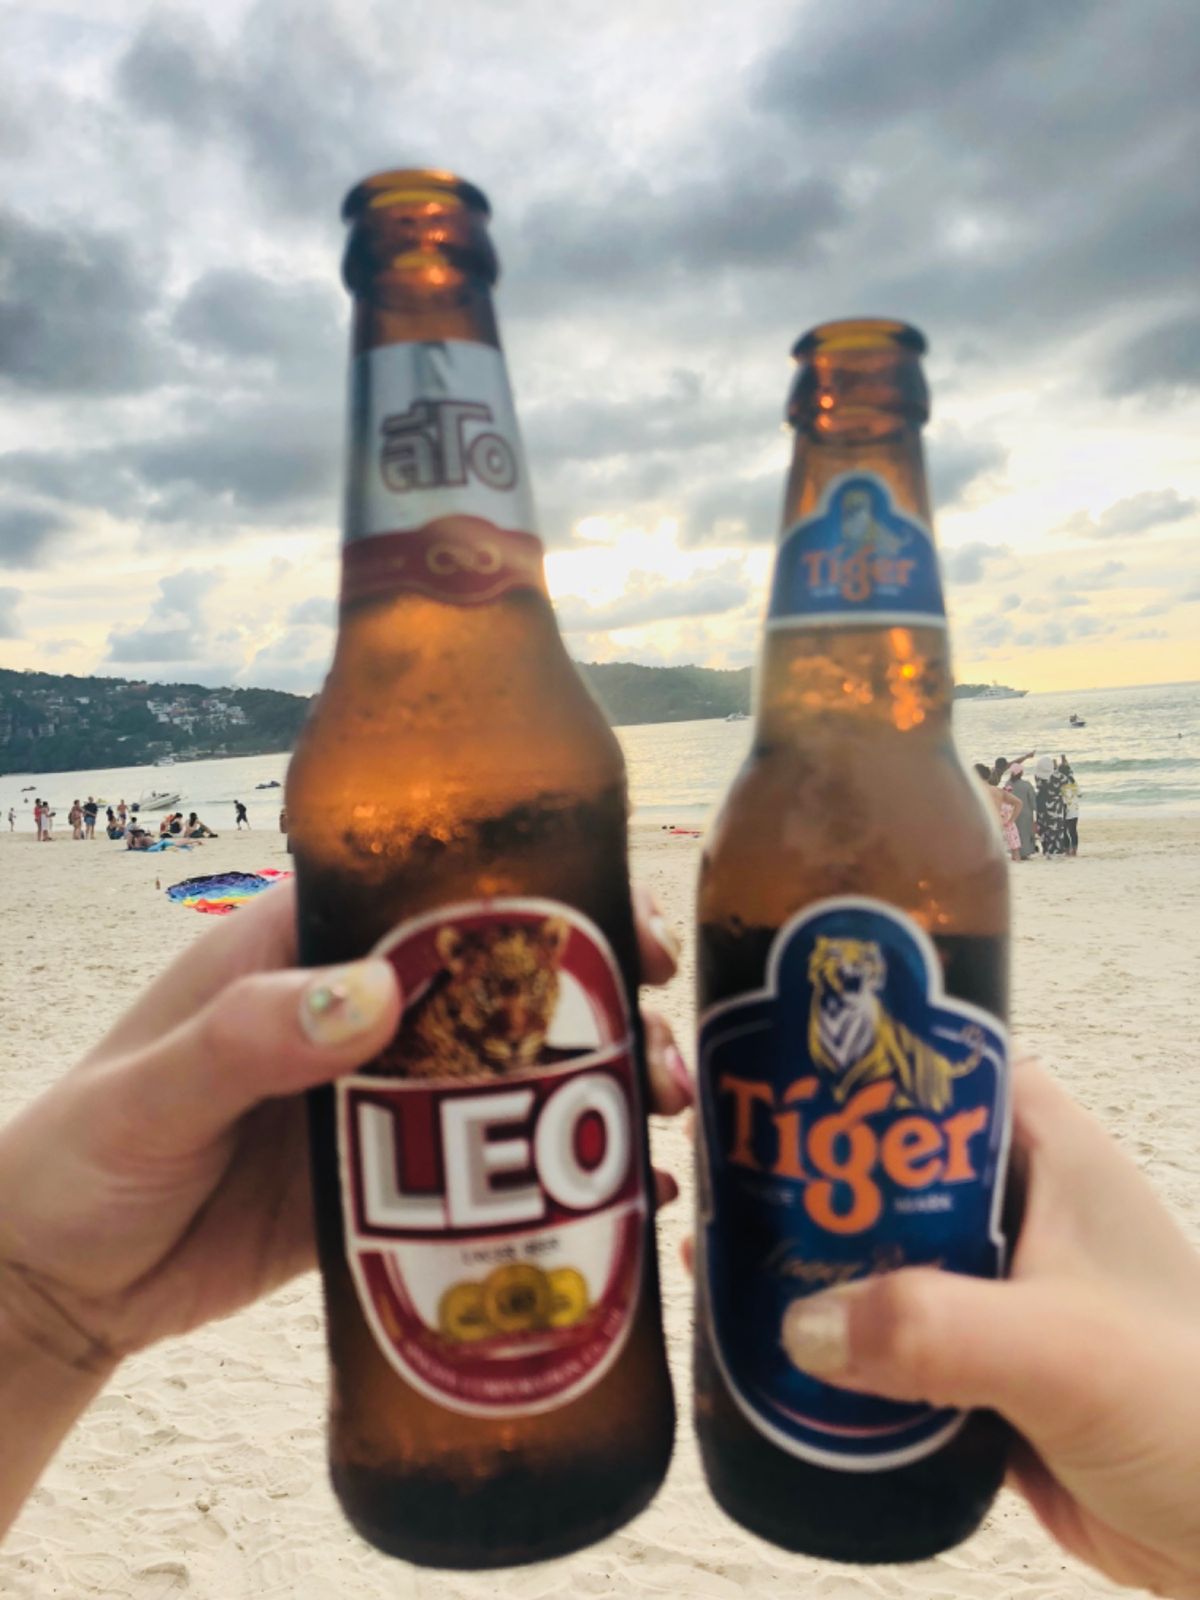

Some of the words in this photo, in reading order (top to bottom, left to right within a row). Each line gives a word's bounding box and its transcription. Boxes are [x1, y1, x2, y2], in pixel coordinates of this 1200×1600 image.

[802, 544, 916, 602] Tiger
[356, 1071, 632, 1230] LEO
[719, 1075, 989, 1235] Tiger
